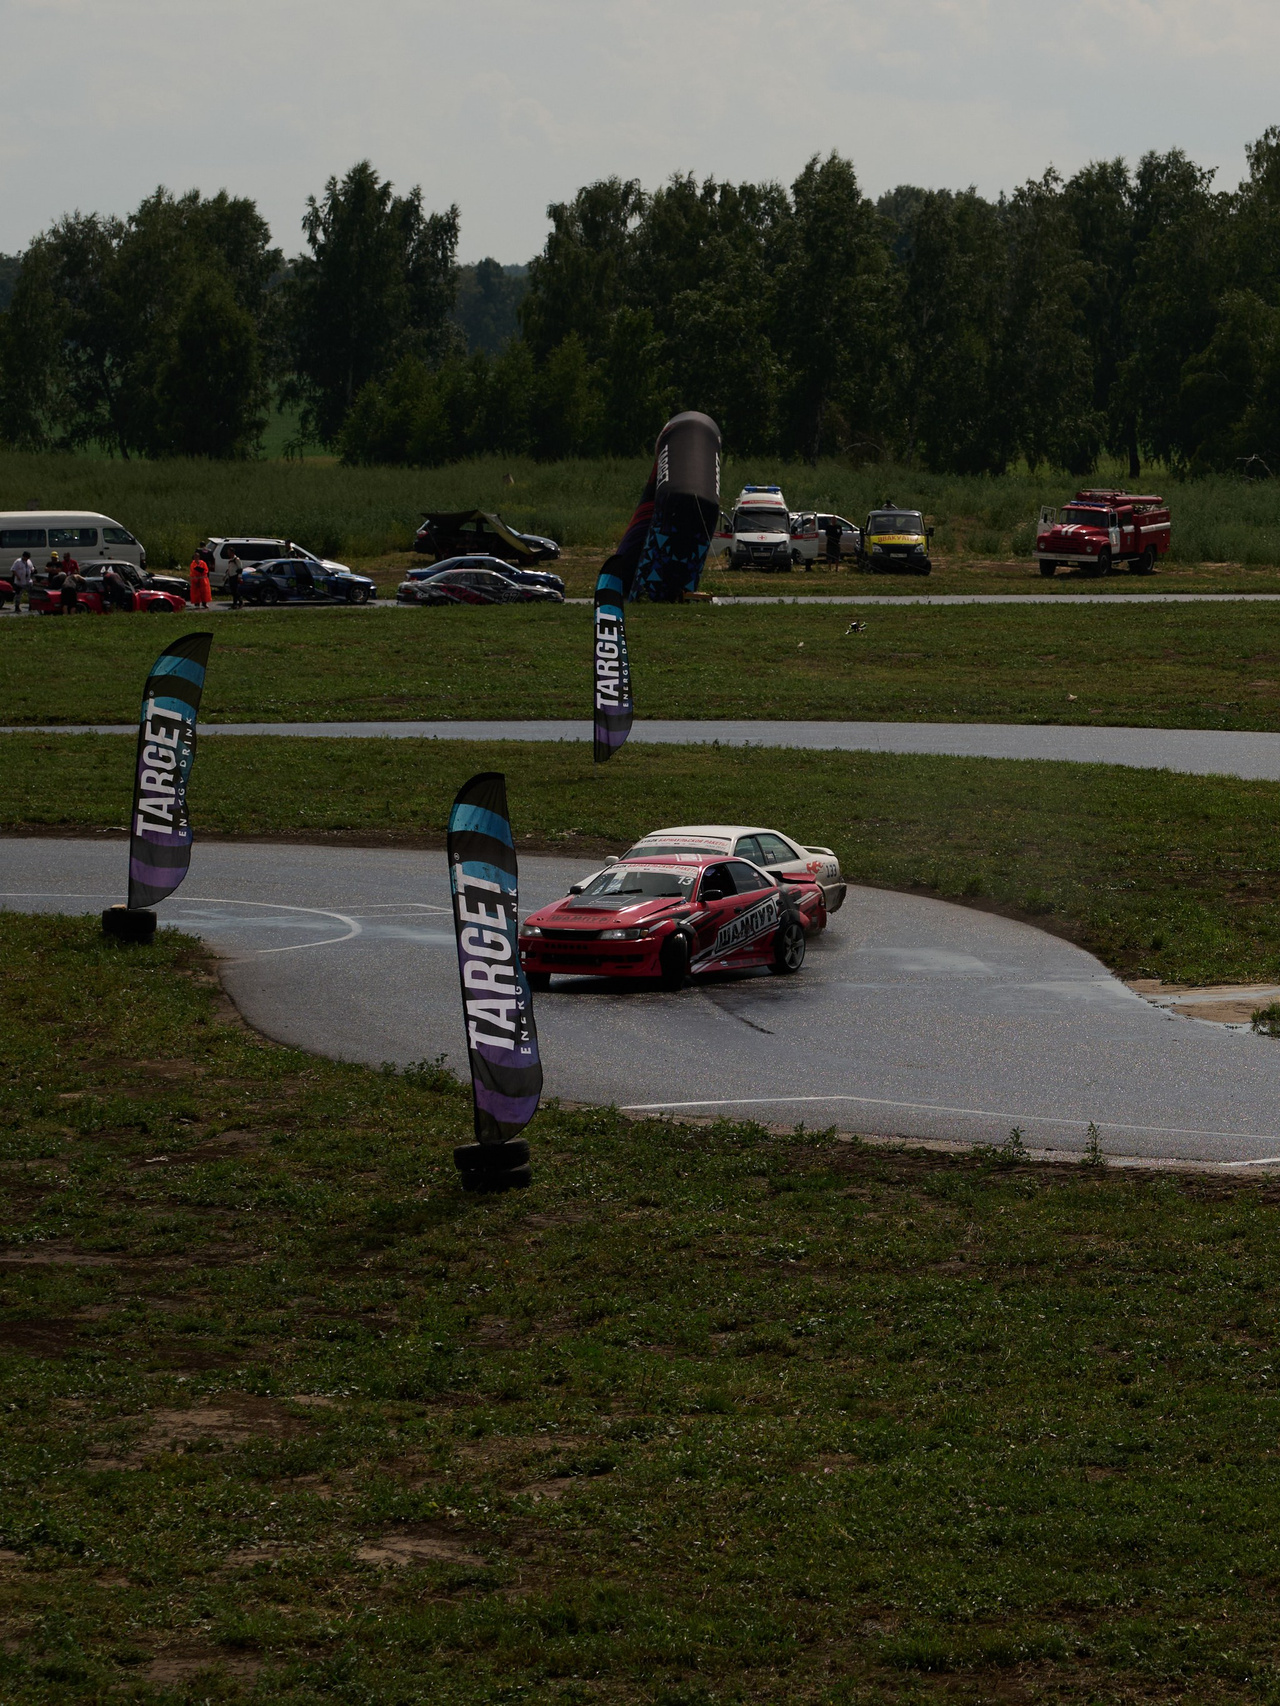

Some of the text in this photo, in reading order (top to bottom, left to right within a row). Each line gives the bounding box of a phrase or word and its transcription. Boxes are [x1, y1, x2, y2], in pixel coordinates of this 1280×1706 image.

[596, 611, 620, 710] TARGET
[621, 660, 630, 708] ENERGY
[179, 717, 193, 768] DRINK
[136, 698, 182, 837] TARGET
[677, 876, 694, 885] 13
[826, 864, 838, 877] 133
[719, 903, 774, 946] ШАМПУР
[456, 862, 517, 1051] TARGET
